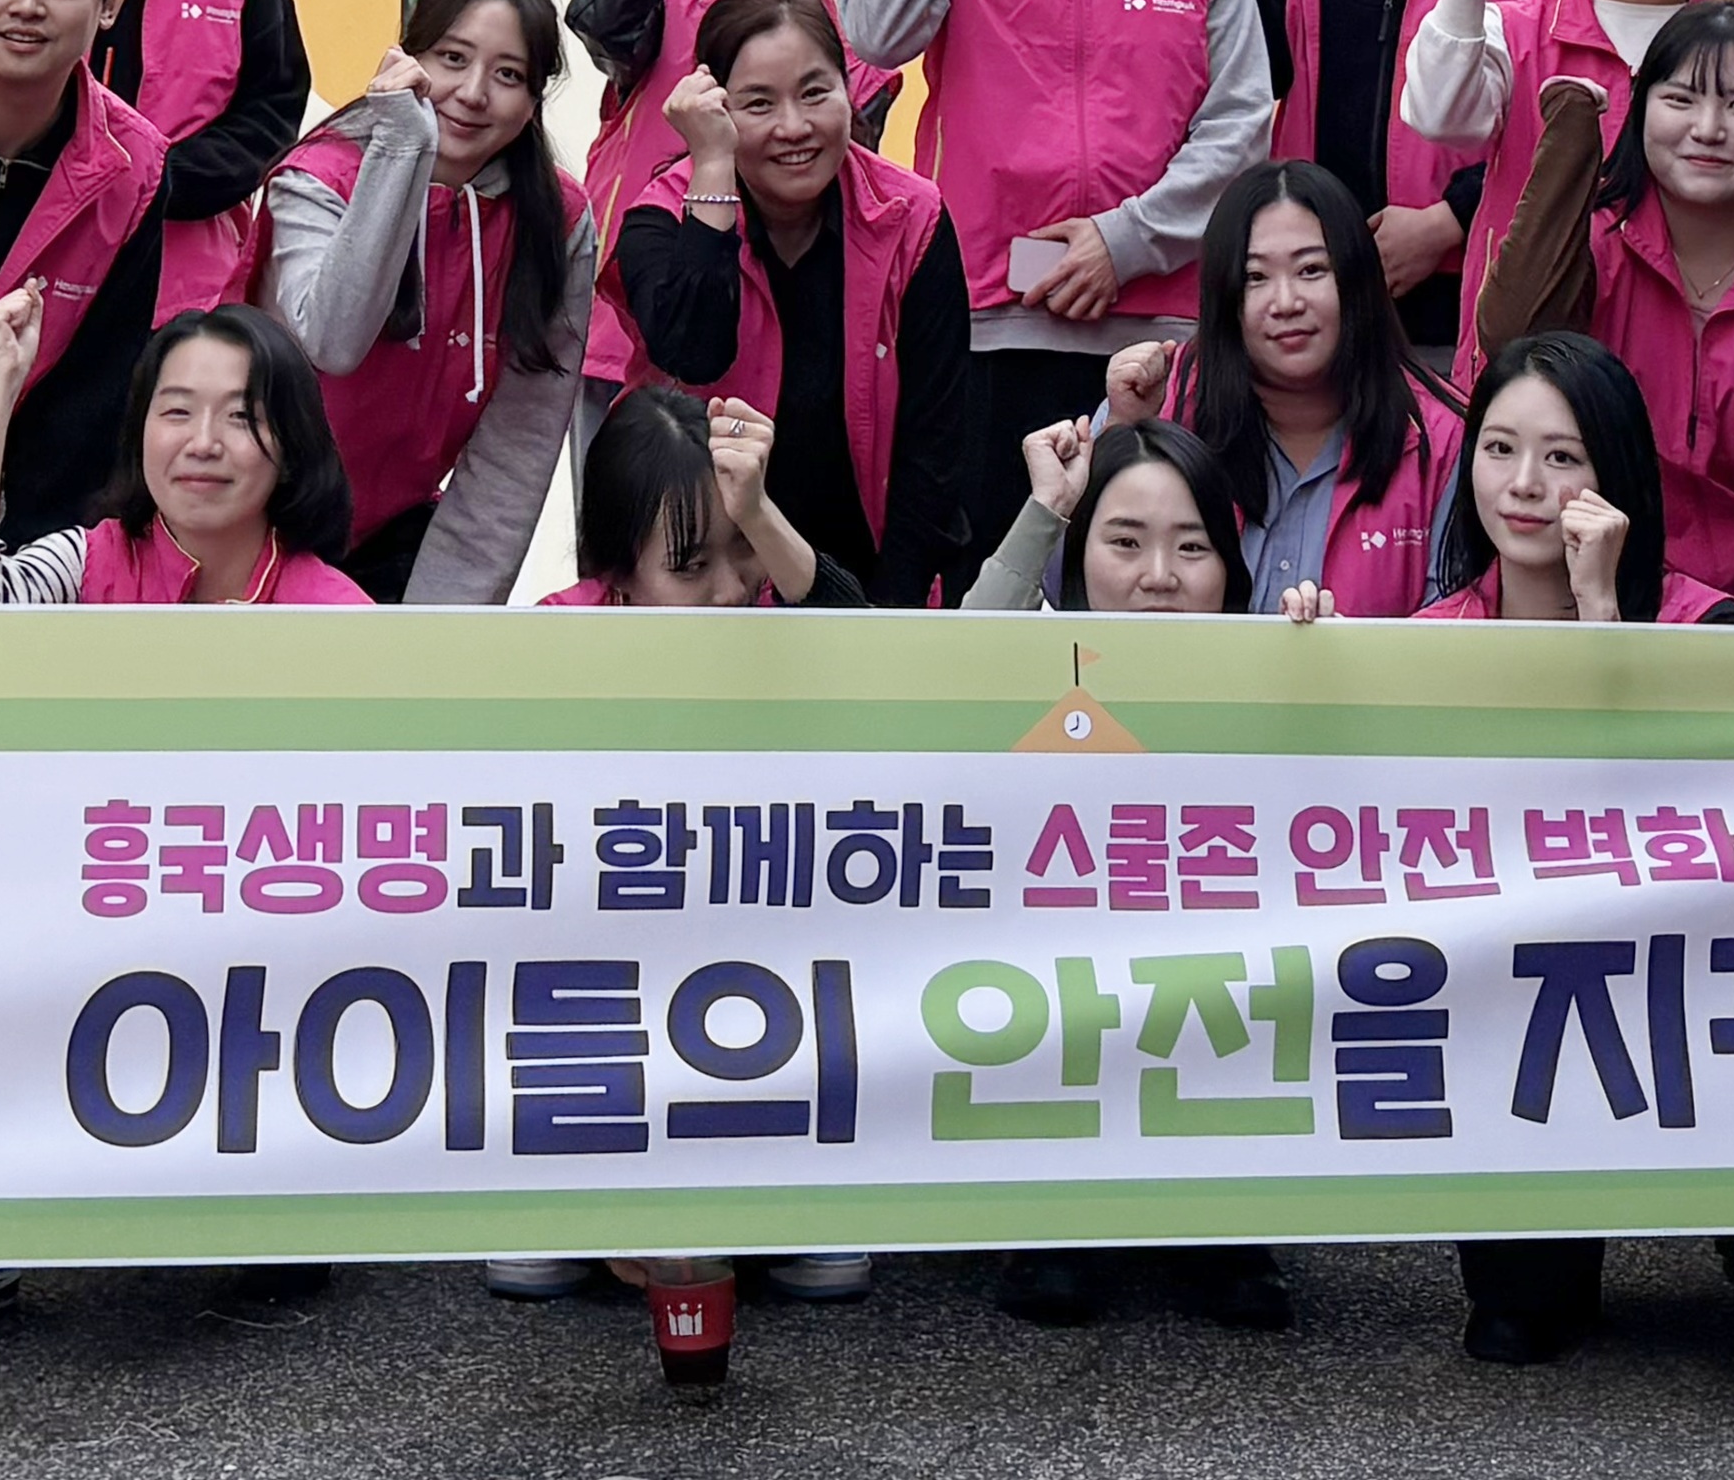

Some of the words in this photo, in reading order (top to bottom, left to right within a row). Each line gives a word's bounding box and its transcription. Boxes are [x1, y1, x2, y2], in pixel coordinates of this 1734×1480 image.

[80, 798, 564, 918] 흥국생명과
[593, 799, 993, 911] 함께하는
[1022, 803, 1261, 912] 스쿨존
[1288, 805, 1501, 907] 안전
[65, 959, 858, 1156] 아이들의
[920, 936, 1454, 1140] 안전을
